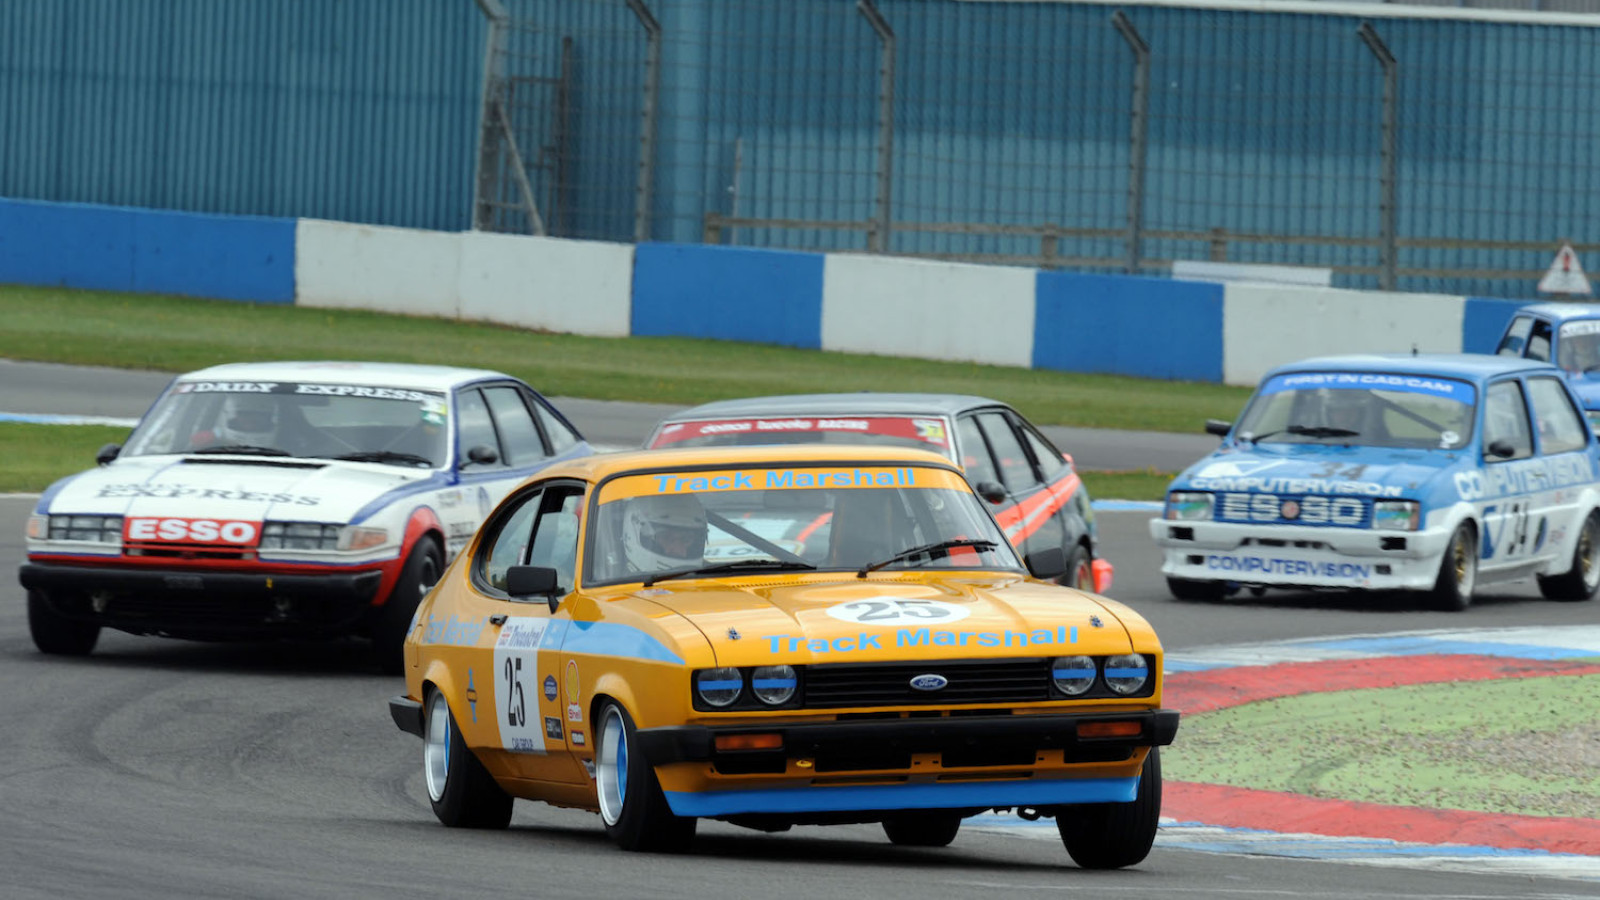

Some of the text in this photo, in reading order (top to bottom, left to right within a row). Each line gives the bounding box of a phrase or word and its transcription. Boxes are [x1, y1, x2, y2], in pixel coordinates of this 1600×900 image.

[1284, 375, 1333, 386] FIRST
[1336, 375, 1358, 383] IN
[194, 382, 434, 401] DAILY EXPRESS
[652, 468, 916, 493] Track Marshall
[1310, 461, 1368, 480] 34
[1453, 454, 1593, 501] COMPUTERVISION
[94, 488, 322, 505] EXPRESS
[1189, 477, 1402, 496] COMPUTERVISION
[129, 518, 255, 542] ESSO
[1208, 555, 1371, 578] COMPUTERVISION
[846, 599, 952, 621] 25
[761, 626, 1079, 653] Track Marshall
[504, 657, 526, 727] 25
[918, 678, 941, 689] Ford
[568, 708, 582, 720] Shell
